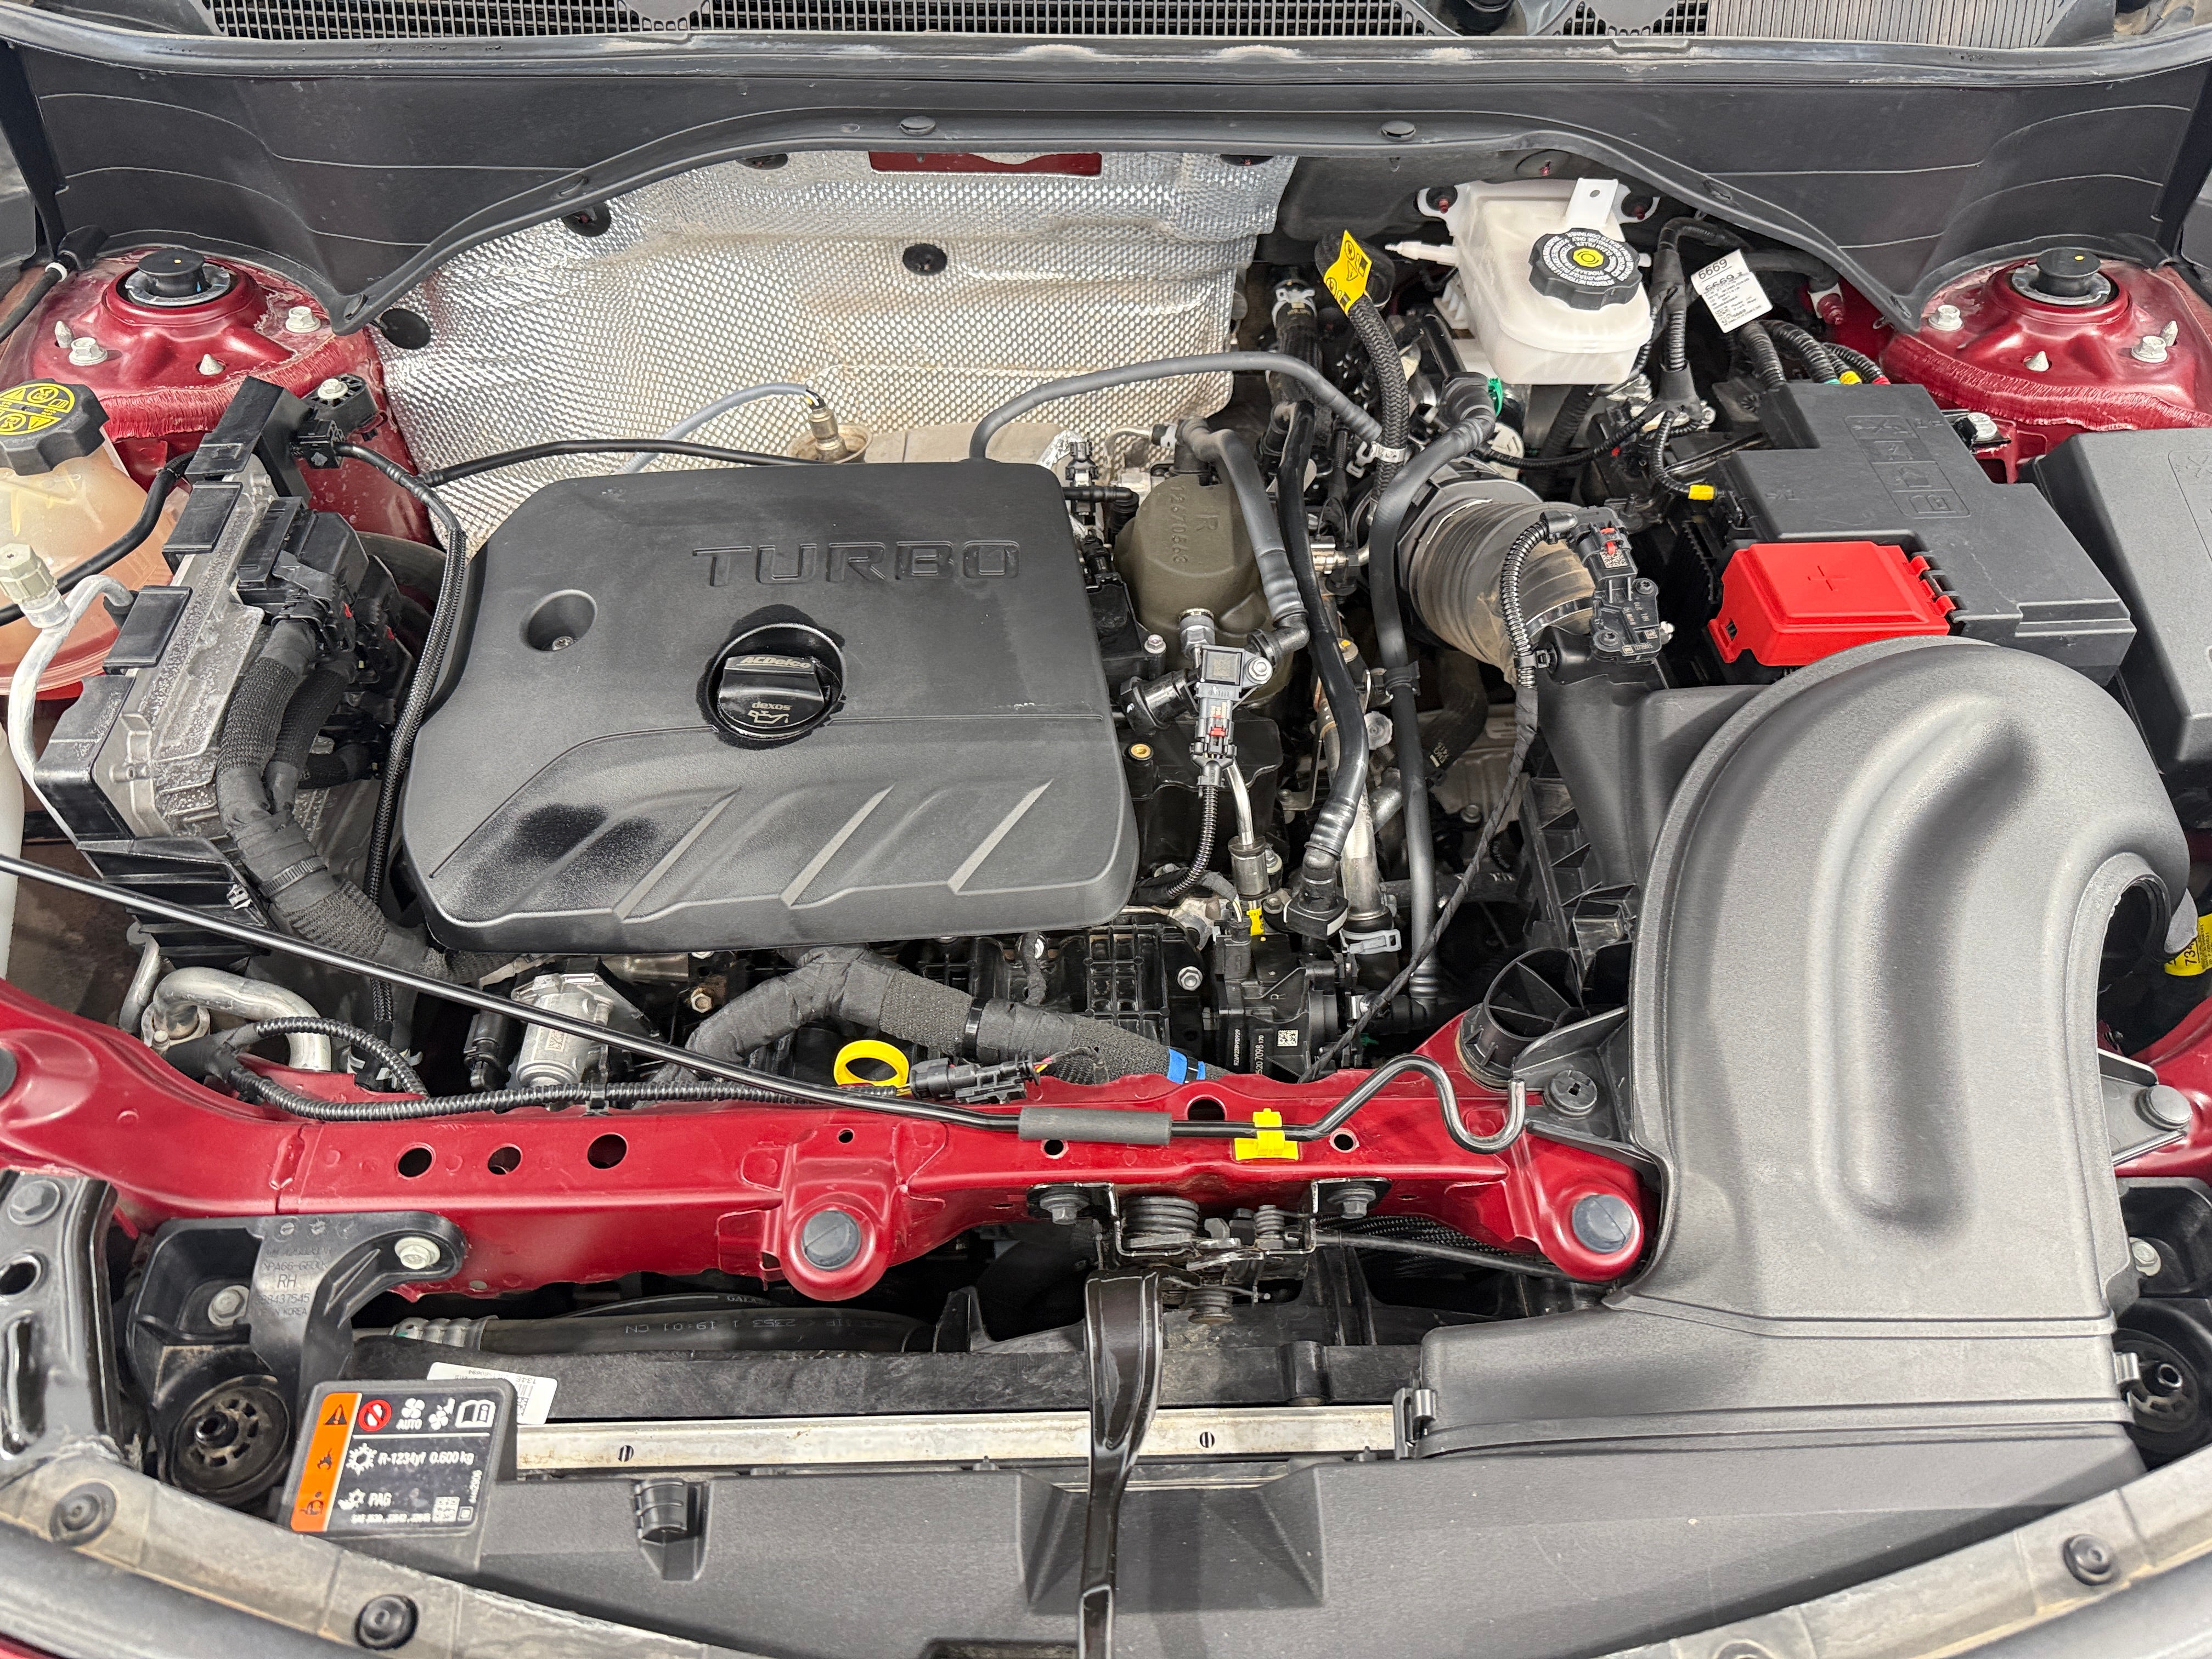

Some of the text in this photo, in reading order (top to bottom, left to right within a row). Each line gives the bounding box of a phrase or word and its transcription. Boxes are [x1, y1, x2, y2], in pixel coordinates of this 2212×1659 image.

[1594, 244, 1614, 256] CLEAN
[1698, 258, 1728, 280] 6669
[1558, 272, 1586, 285] NETTOYER
[1195, 512, 1220, 532] R
[692, 540, 1021, 586] TURBO
[740, 656, 811, 669] ACDelco
[751, 701, 792, 712] dexos
[277, 1273, 298, 1288] RH
[283, 1307, 307, 1316] KOREA
[625, 1324, 650, 1334] CN
[396, 1418, 422, 1430] AUTO
[428, 1451, 460, 1464] 0.600
[460, 1451, 475, 1465] kg
[368, 1492, 392, 1507] PAG
